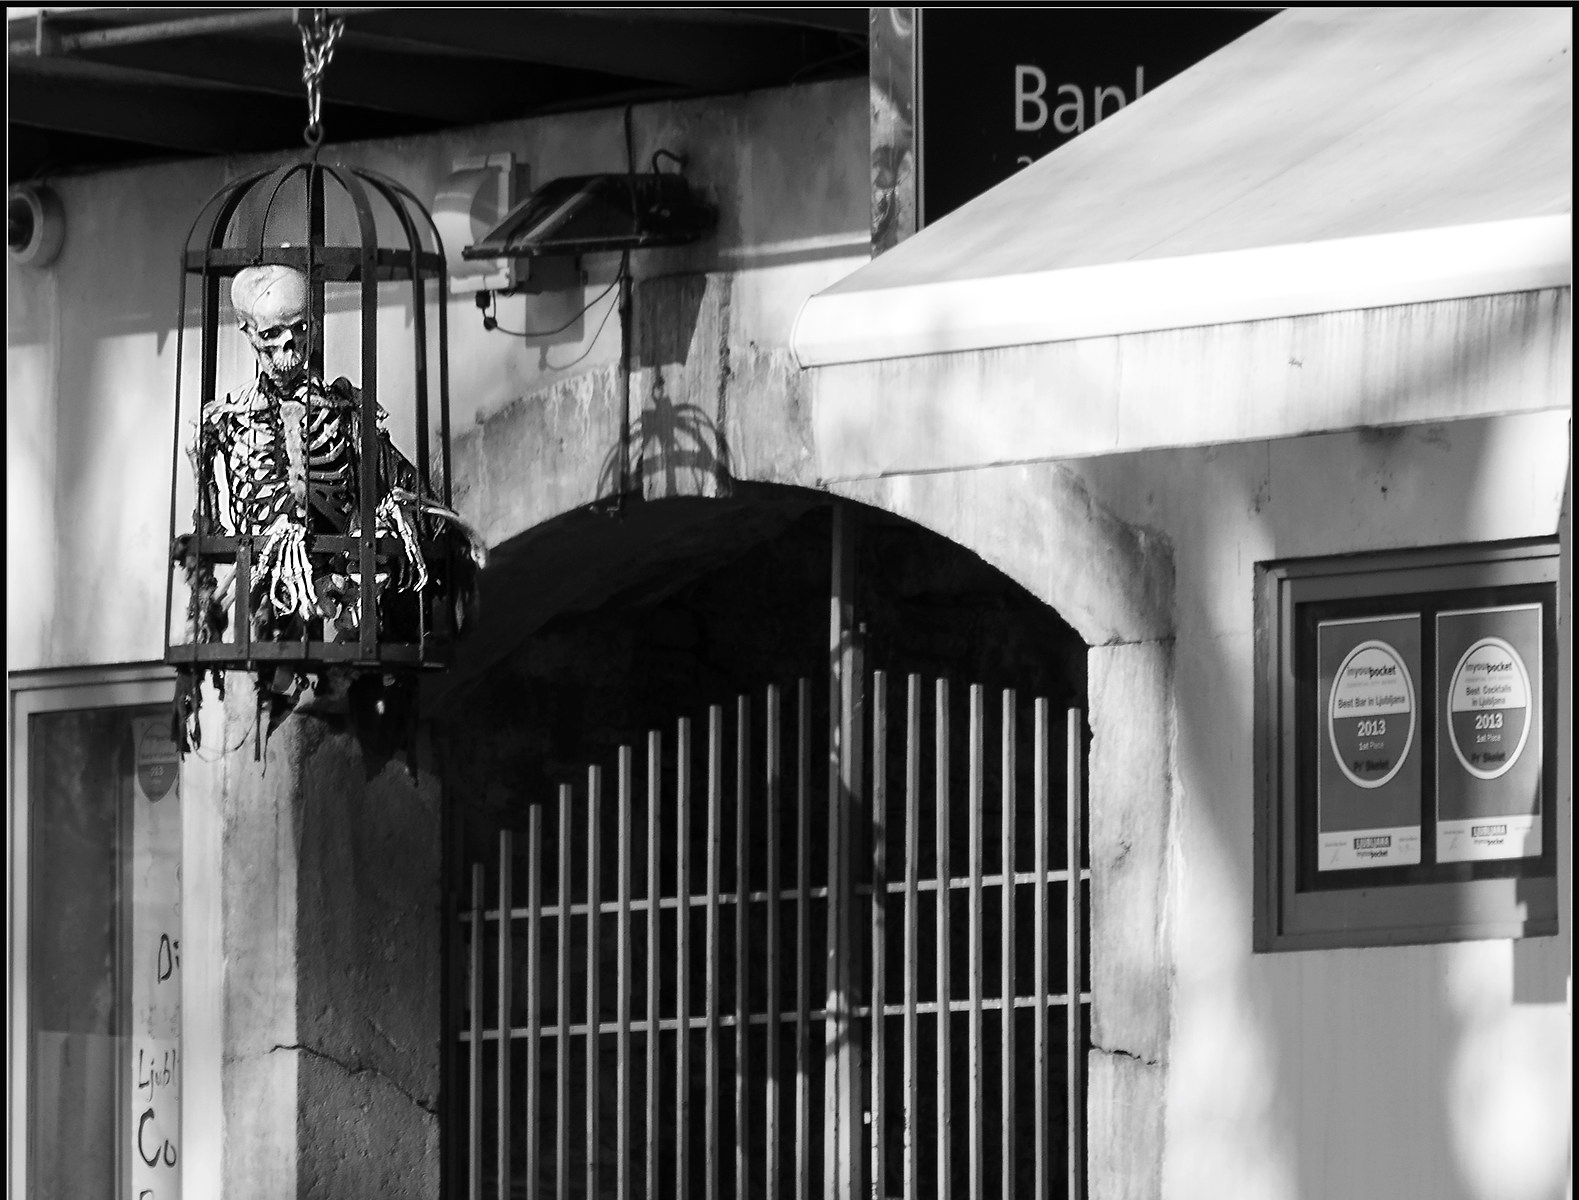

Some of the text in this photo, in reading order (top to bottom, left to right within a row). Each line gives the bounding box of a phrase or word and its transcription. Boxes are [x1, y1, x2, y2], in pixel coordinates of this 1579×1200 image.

[1465, 685, 1480, 696] Best
[1338, 693, 1406, 709] Best Bar in Ljubljana
[1472, 697, 1478, 707] in
[1475, 711, 1504, 730] 2013
[1357, 719, 1386, 737] 2013
[1358, 741, 1369, 751] 1st
